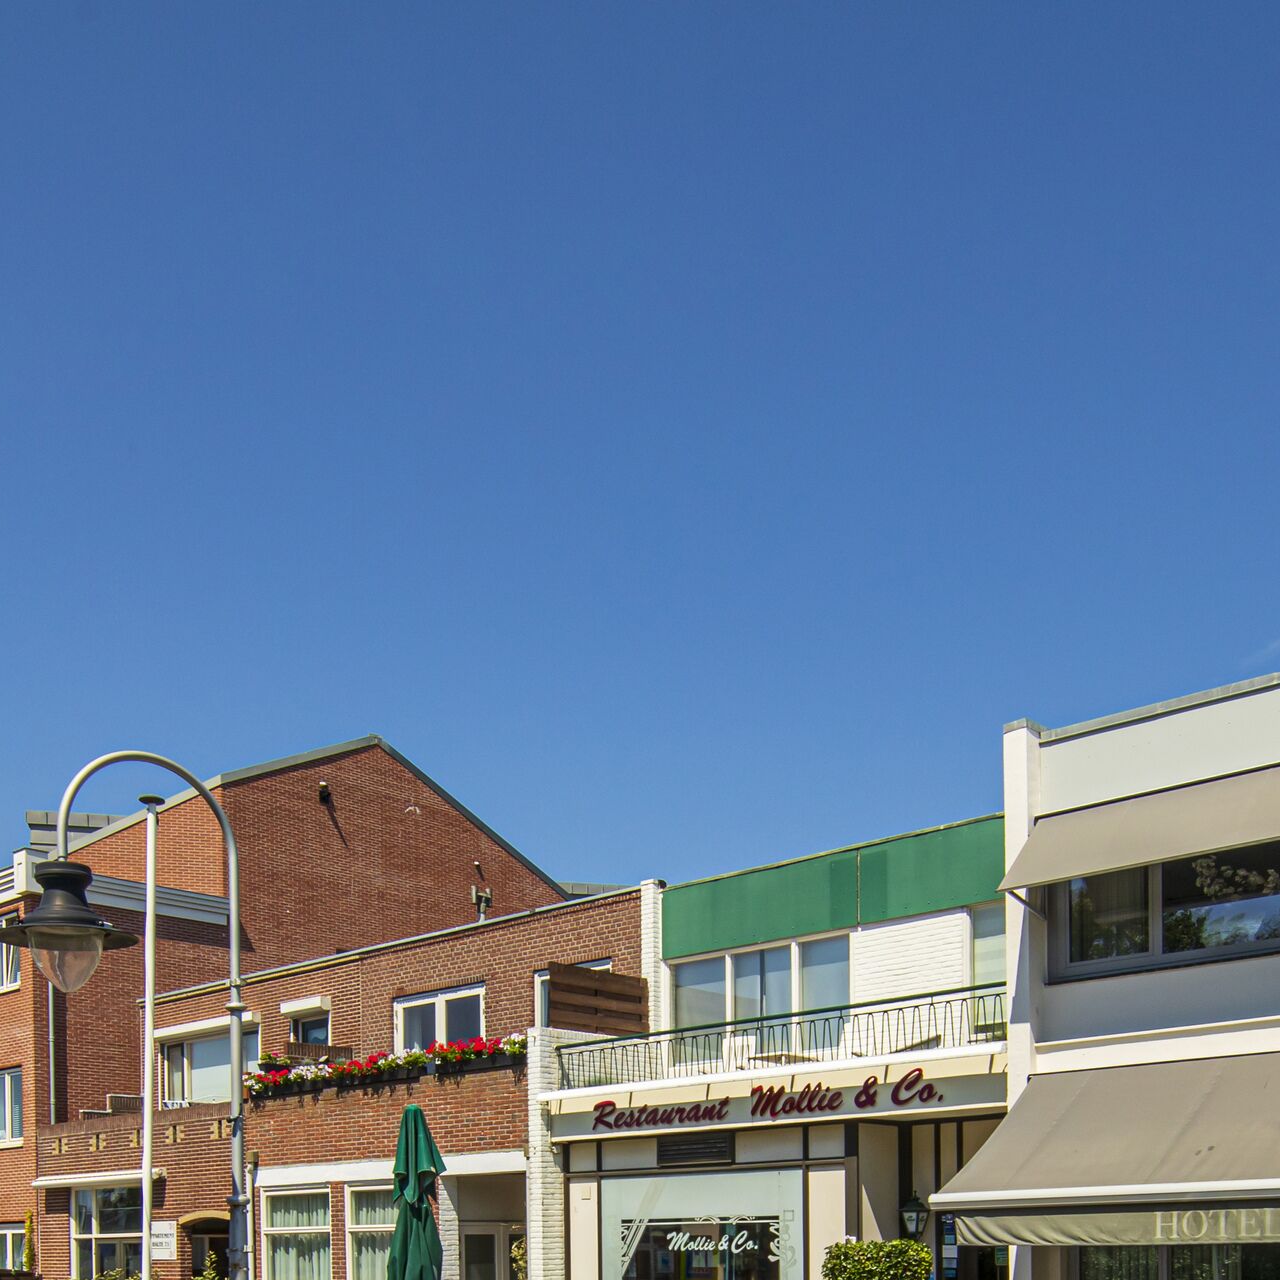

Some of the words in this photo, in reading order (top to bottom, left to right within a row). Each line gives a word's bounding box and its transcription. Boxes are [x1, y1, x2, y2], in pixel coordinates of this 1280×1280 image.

[592, 1096, 729, 1131] Restaurant
[751, 1081, 844, 1119] Mollie
[854, 1075, 878, 1109] &
[891, 1068, 944, 1106] Co.
[666, 1231, 715, 1252] Mollie
[718, 1234, 729, 1251] &
[731, 1230, 758, 1254] Co.
